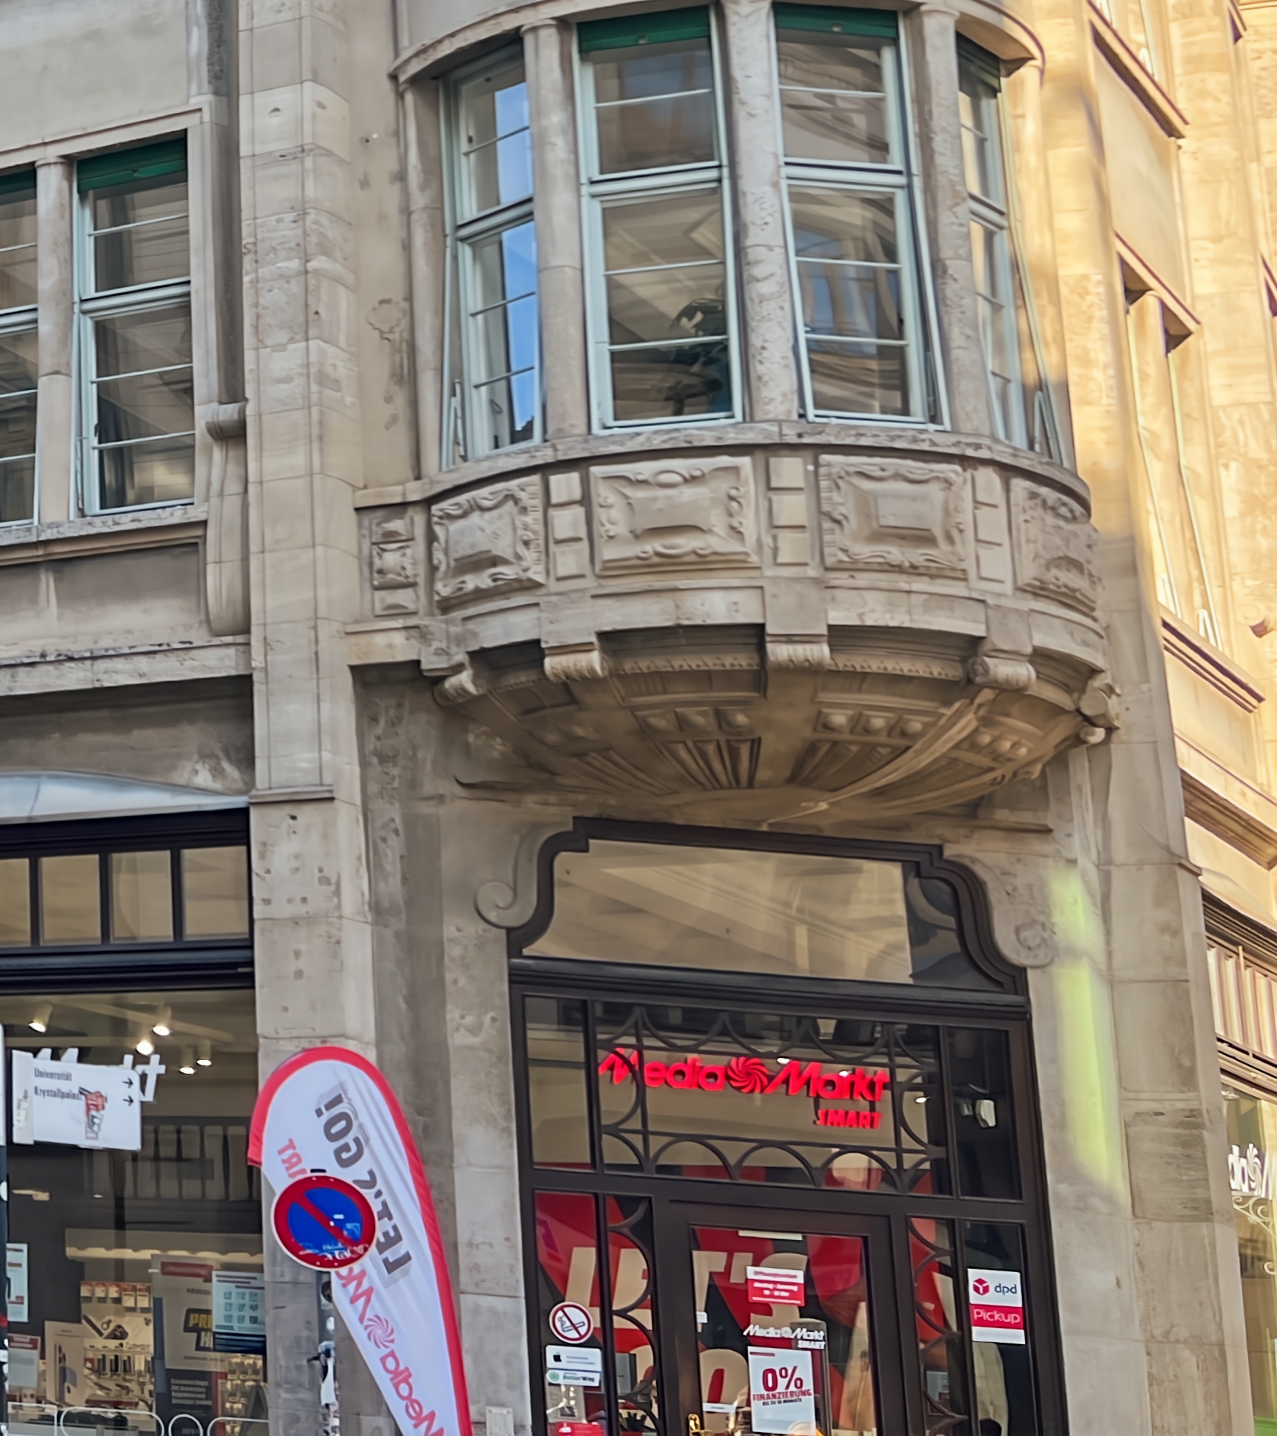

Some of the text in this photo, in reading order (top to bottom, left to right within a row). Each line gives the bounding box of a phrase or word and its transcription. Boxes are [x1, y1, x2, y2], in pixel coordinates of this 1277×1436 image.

[599, 1048, 890, 1102] Media Markt
[816, 1109, 883, 1130] SMART
[994, 1283, 1018, 1296] dpd
[973, 1308, 1021, 1325] Pickup
[762, 1365, 804, 1392] 0%
[753, 1389, 813, 1402] FINANZIERUNG
